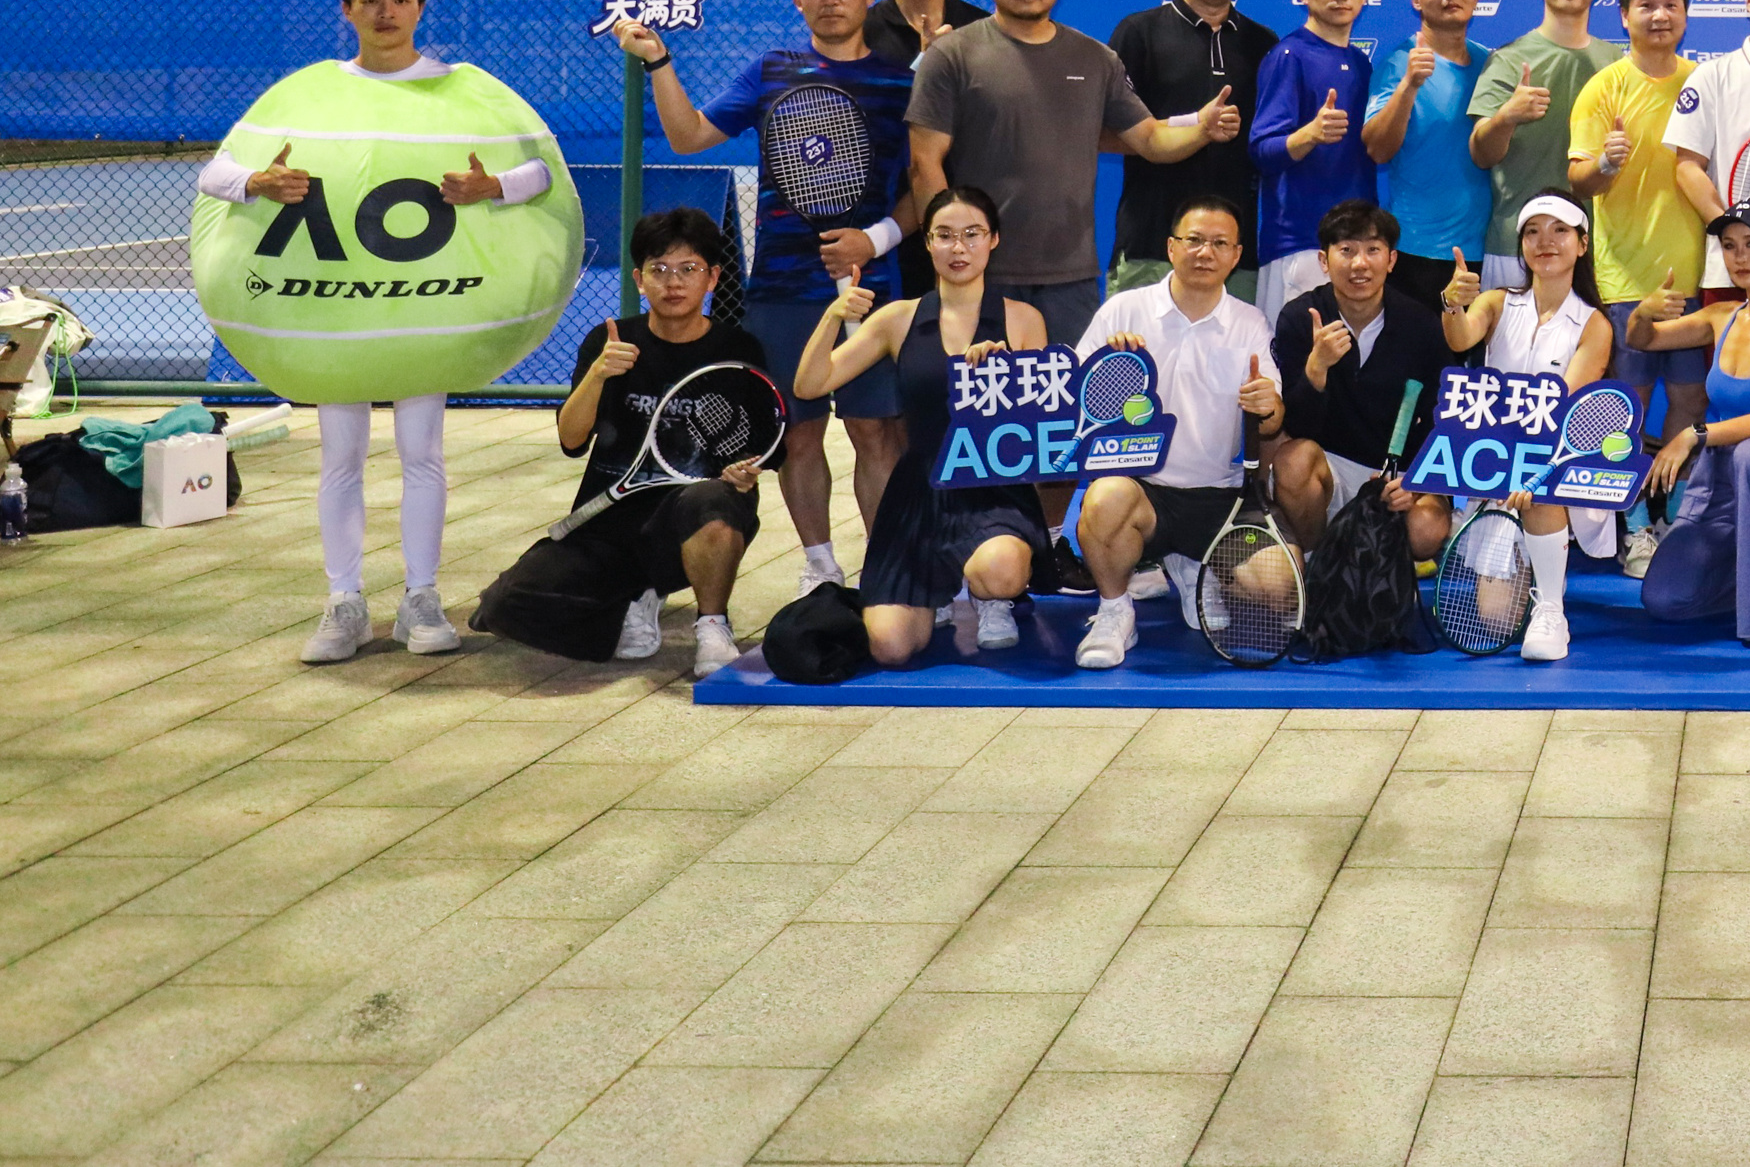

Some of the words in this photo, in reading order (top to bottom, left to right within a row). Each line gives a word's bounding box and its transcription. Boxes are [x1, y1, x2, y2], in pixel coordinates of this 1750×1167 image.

[806, 141, 825, 159] 237
[254, 177, 457, 262] AO
[277, 276, 484, 299] DUNLOP
[954, 352, 1076, 417] 球球
[1440, 373, 1562, 435] 球球
[940, 420, 1078, 481] ACE
[1092, 439, 1119, 455] AO
[1121, 438, 1129, 452] 1
[1129, 436, 1160, 445] POINT
[1127, 443, 1158, 452] SLAM
[1118, 455, 1154, 464] Casarte
[1411, 435, 1554, 495] ACE
[181, 473, 213, 495] AO
[1565, 469, 1592, 484] AO
[1593, 472, 1603, 484] 1
[1603, 473, 1633, 481] POINT
[1599, 479, 1630, 488] SLAM
[1588, 488, 1623, 498] Casarte
